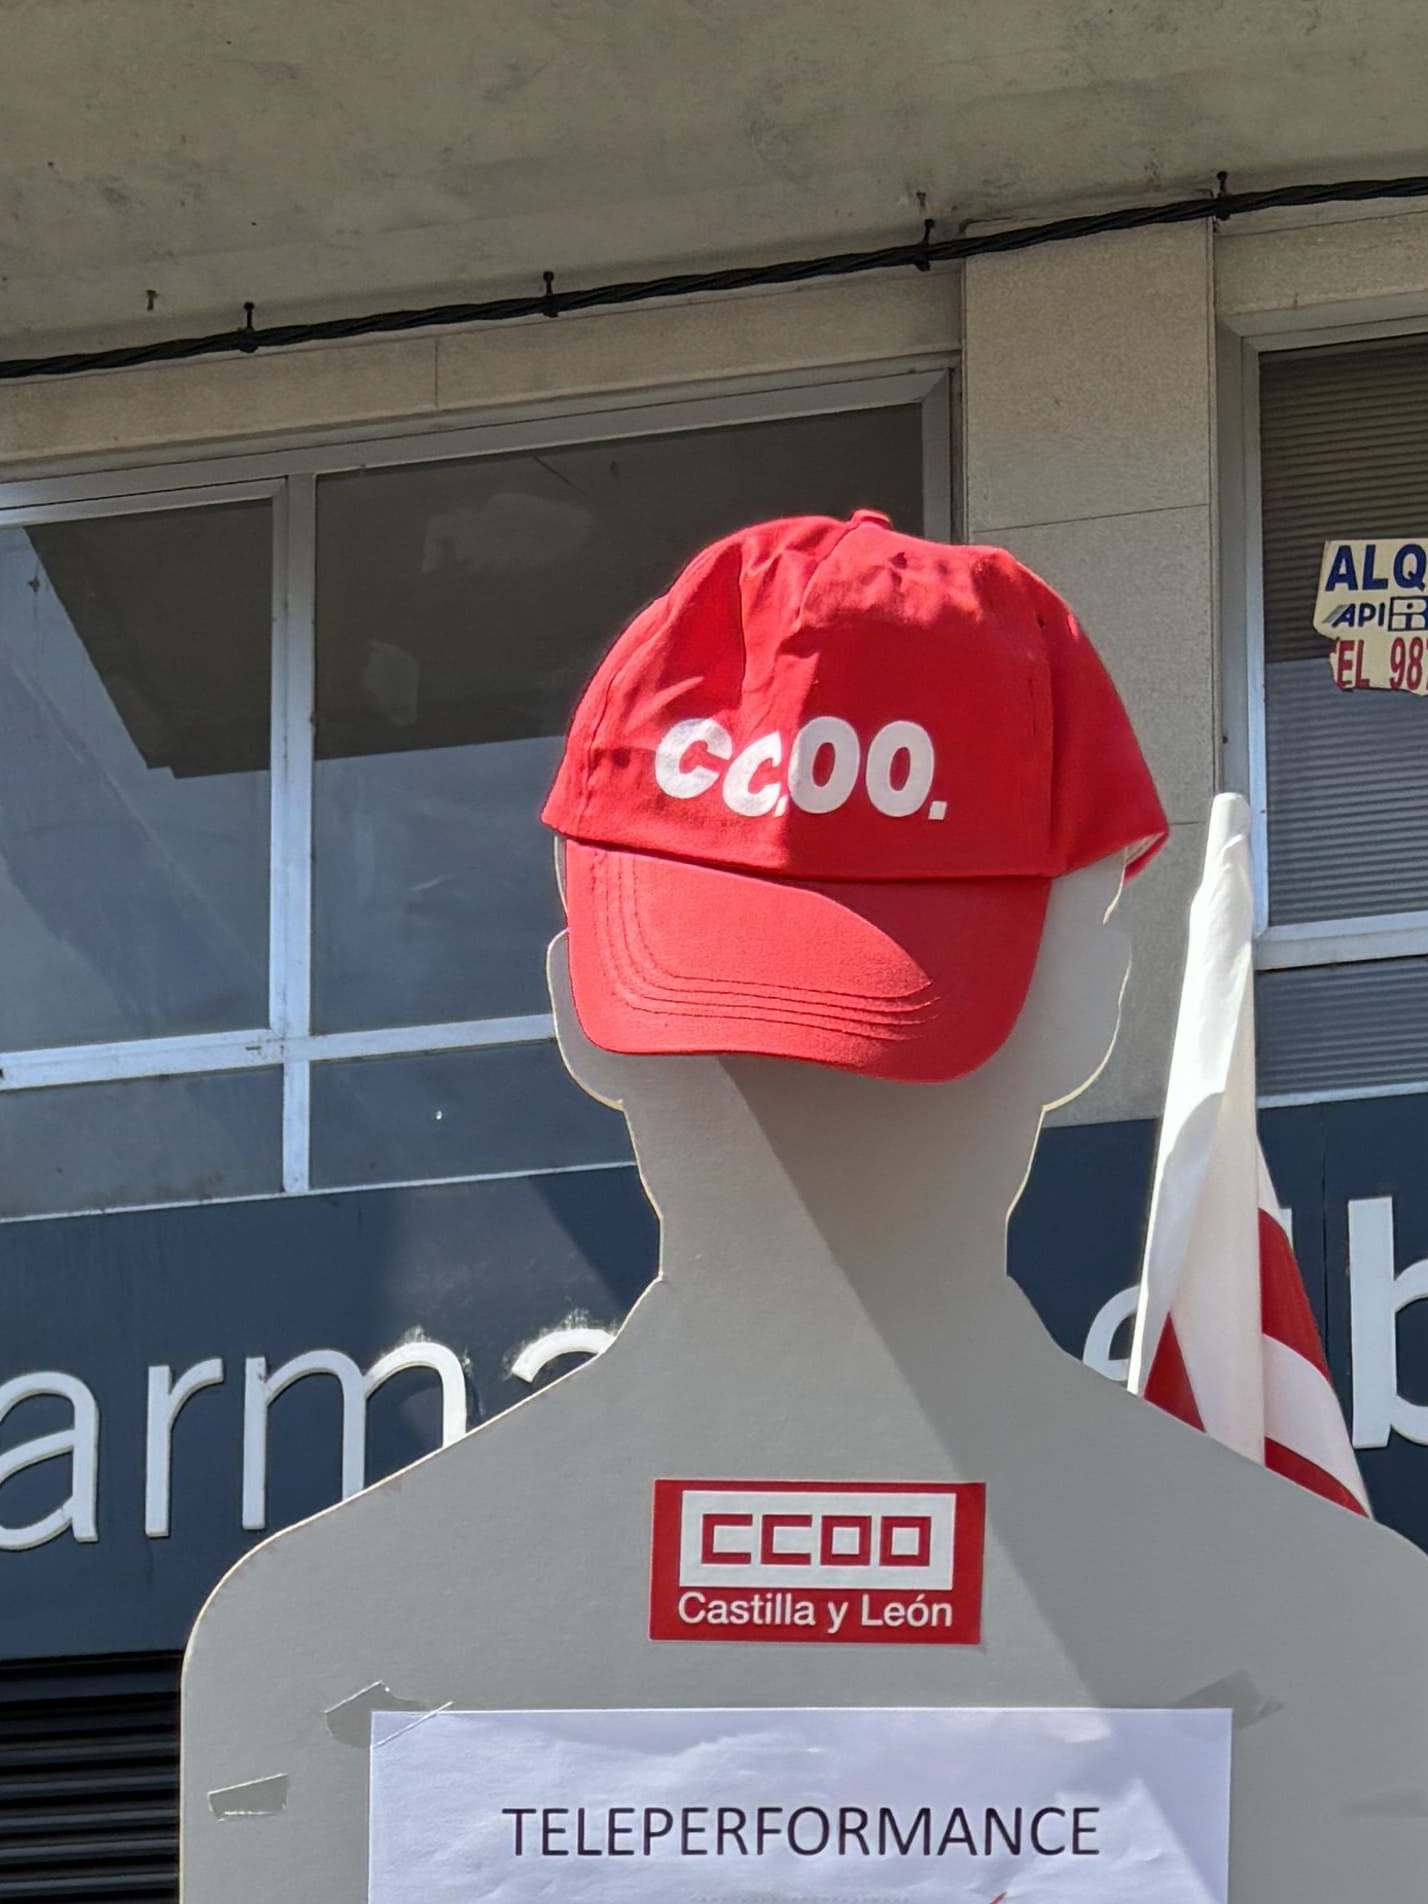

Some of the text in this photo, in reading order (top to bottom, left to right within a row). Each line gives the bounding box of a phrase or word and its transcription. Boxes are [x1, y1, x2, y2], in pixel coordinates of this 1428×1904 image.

[701, 1513, 932, 1567] CCOO
[678, 1591, 953, 1634] Castilla y León
[502, 1807, 1099, 1855] TELEPERFORMANCE
